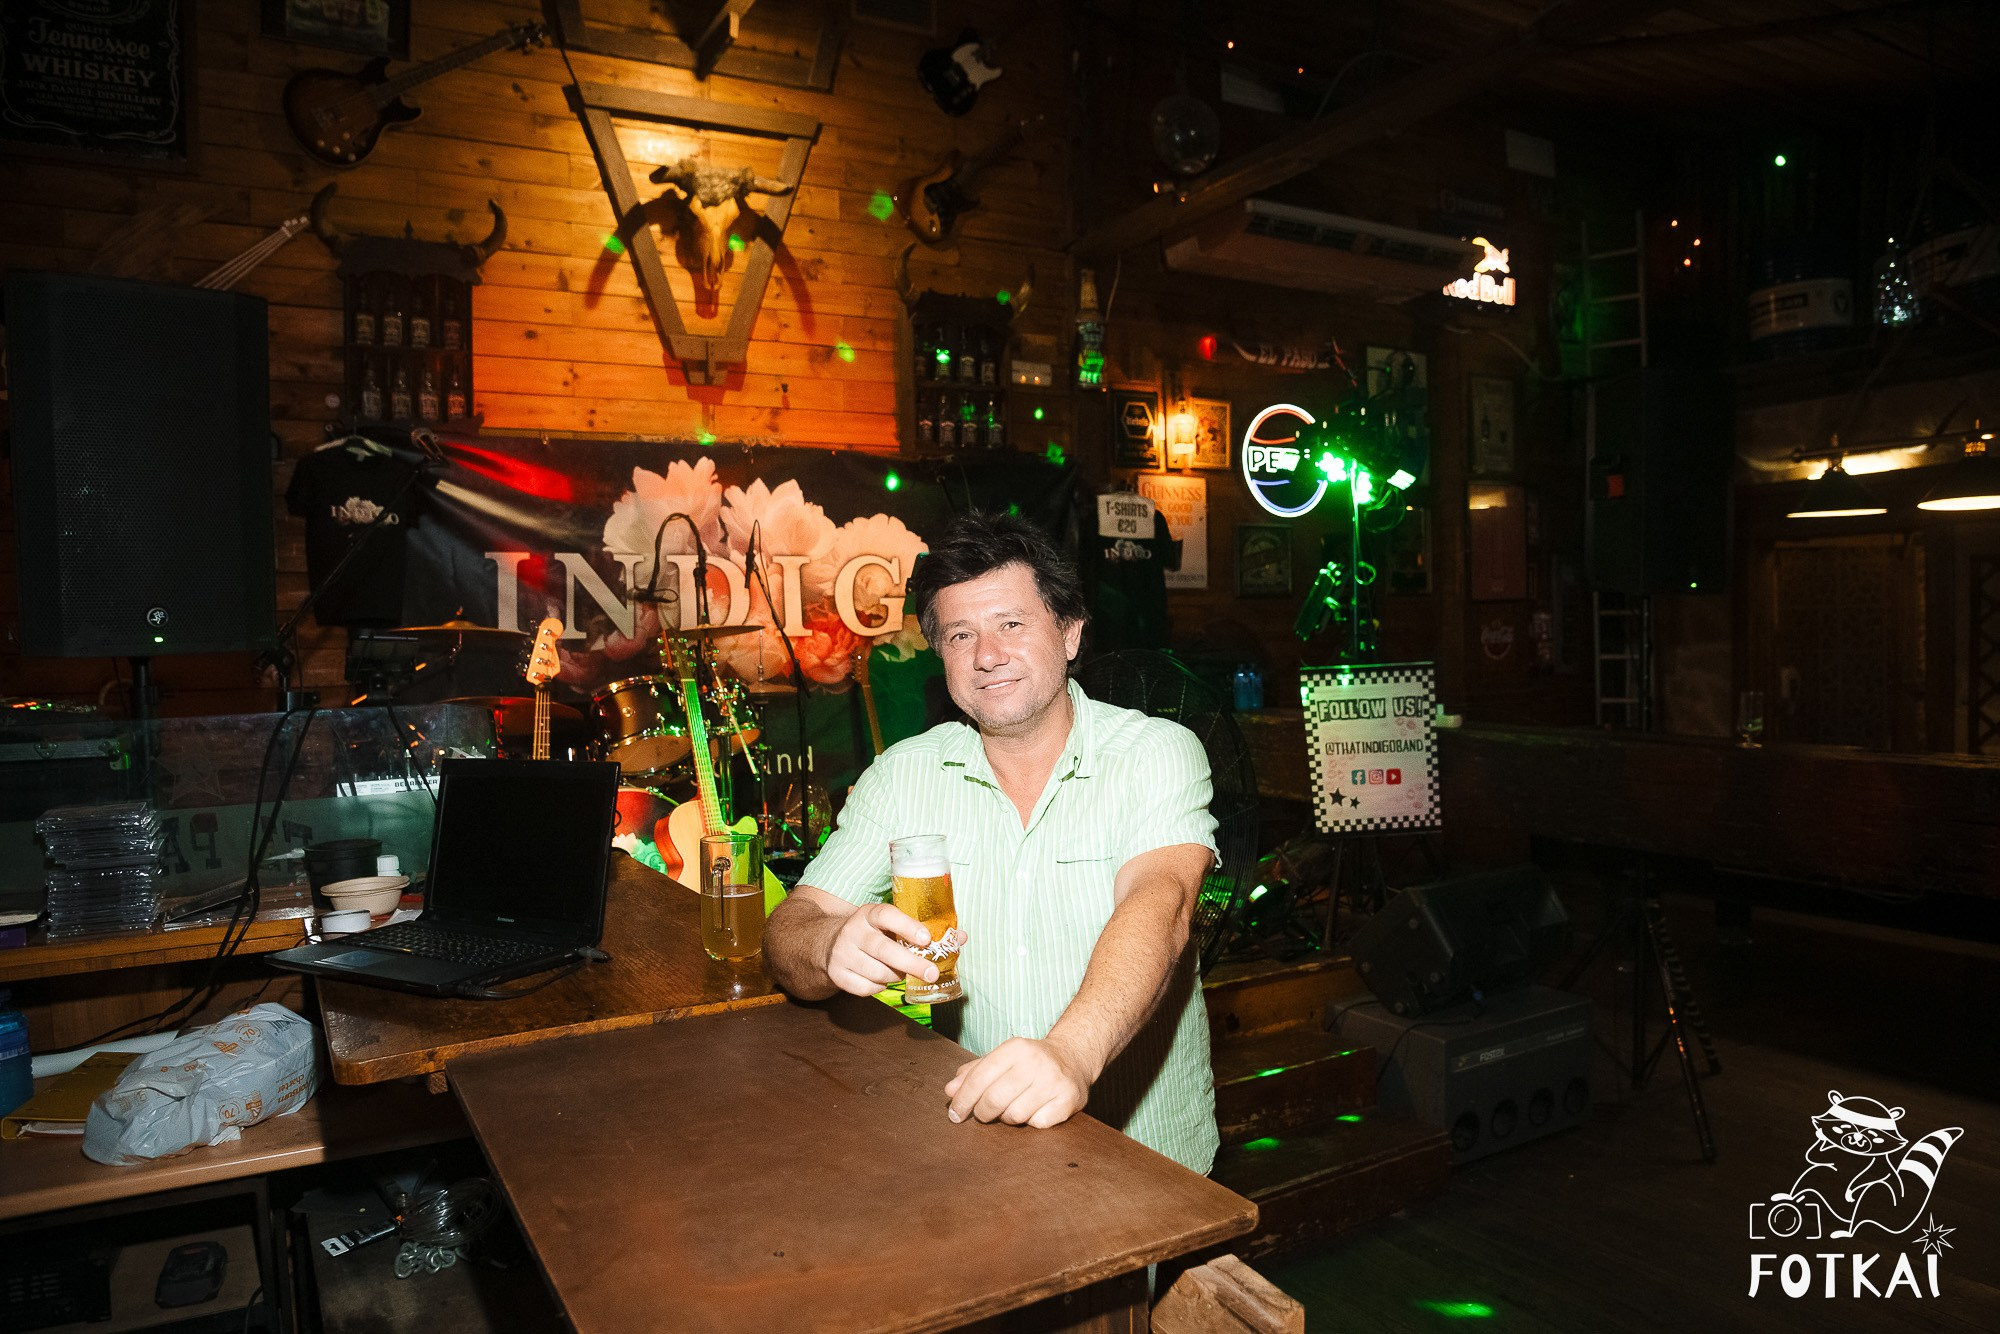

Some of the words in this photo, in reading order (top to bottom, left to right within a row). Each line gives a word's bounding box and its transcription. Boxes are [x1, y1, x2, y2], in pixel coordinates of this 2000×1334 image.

[28, 16, 151, 61] Tennessee
[22, 52, 157, 88] WHISKEY
[1141, 482, 1203, 502] GUINNESS
[1105, 501, 1149, 519] T-SHIRTS
[1117, 518, 1137, 534] €20
[484, 551, 907, 642] INDIG
[1317, 699, 1386, 722] FOLLOW
[1393, 696, 1424, 718] US!
[1325, 739, 1424, 756] @THATINDIGOBAND
